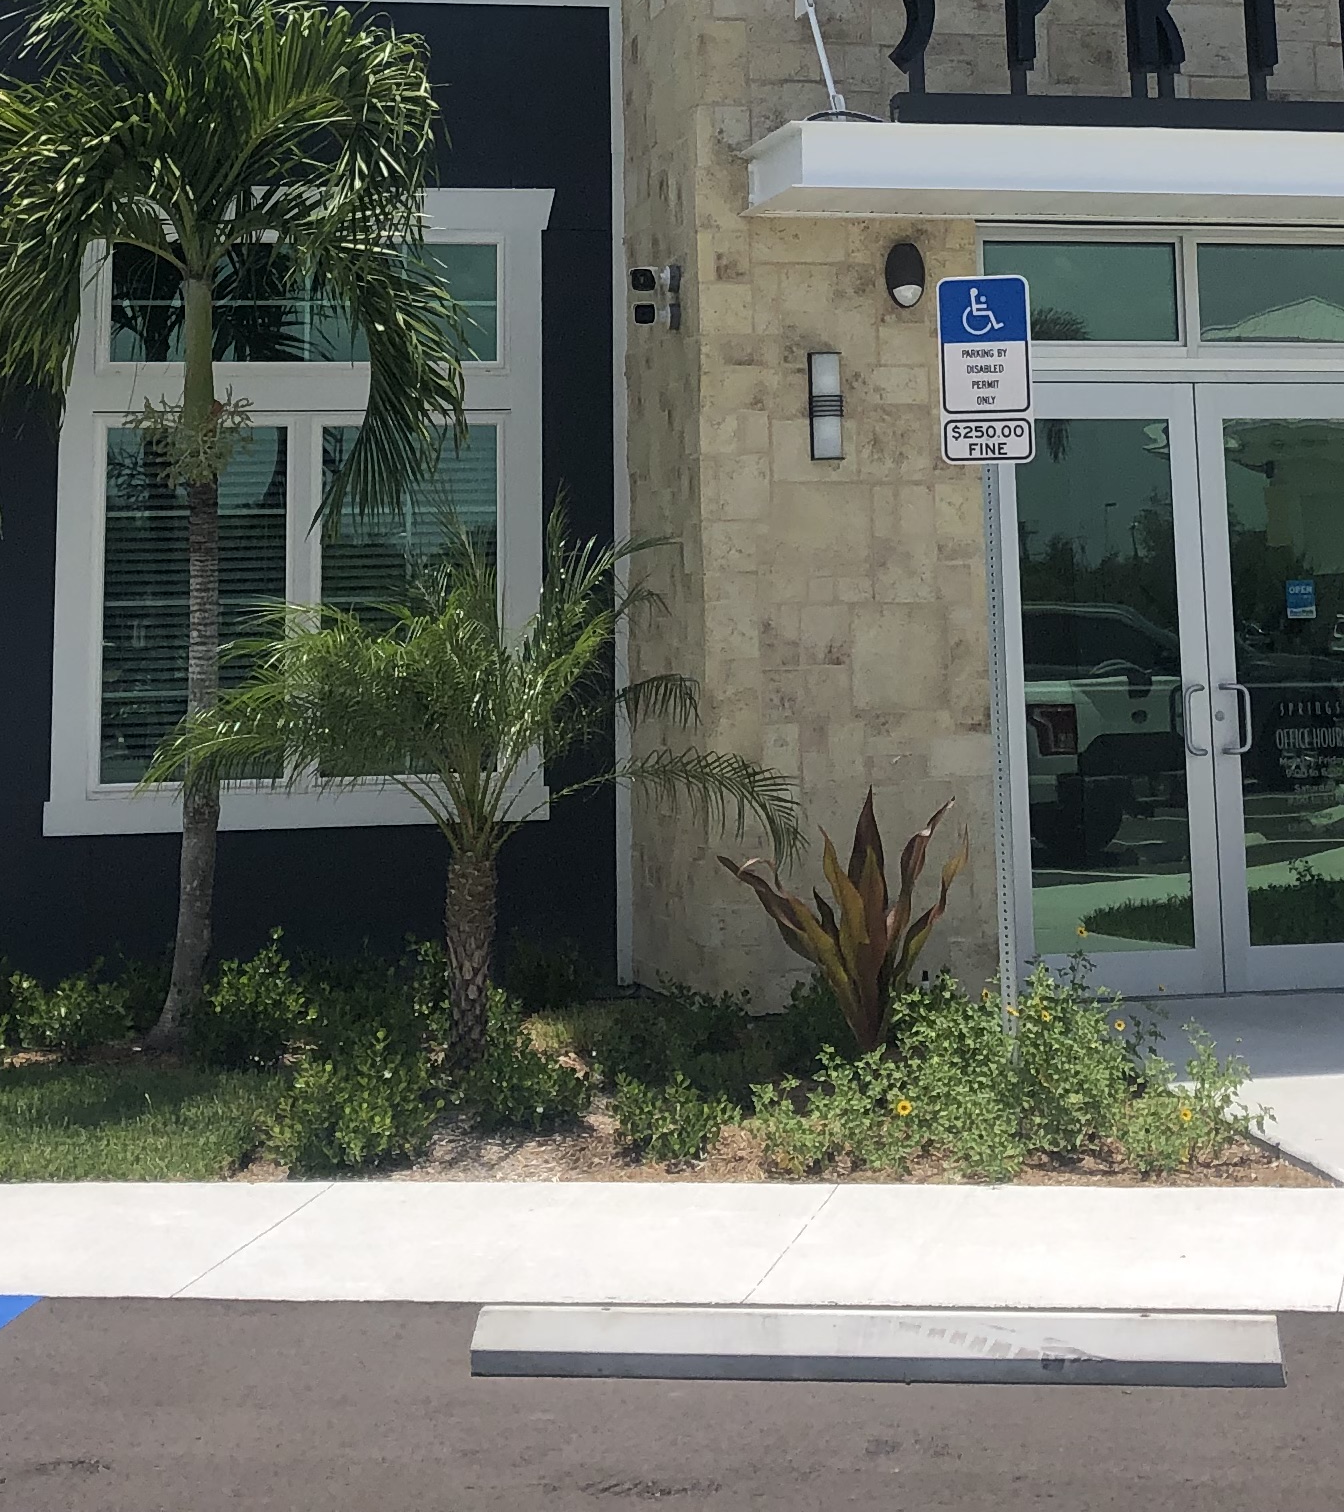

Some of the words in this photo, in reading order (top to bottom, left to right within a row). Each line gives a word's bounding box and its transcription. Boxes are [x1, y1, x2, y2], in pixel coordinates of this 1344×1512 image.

[961, 349, 994, 358] PARKING
[997, 348, 1008, 358] BY
[966, 364, 1004, 374] DISABLED
[971, 380, 1000, 390] PERMIT
[976, 395, 996, 406] ONLY
[951, 424, 1025, 442] $250.00
[969, 442, 1008, 456] FINE
[1289, 586, 1312, 594] OPEN
[1280, 701, 1340, 716] SPRINGS
[1276, 728, 1311, 749] OFFICE
